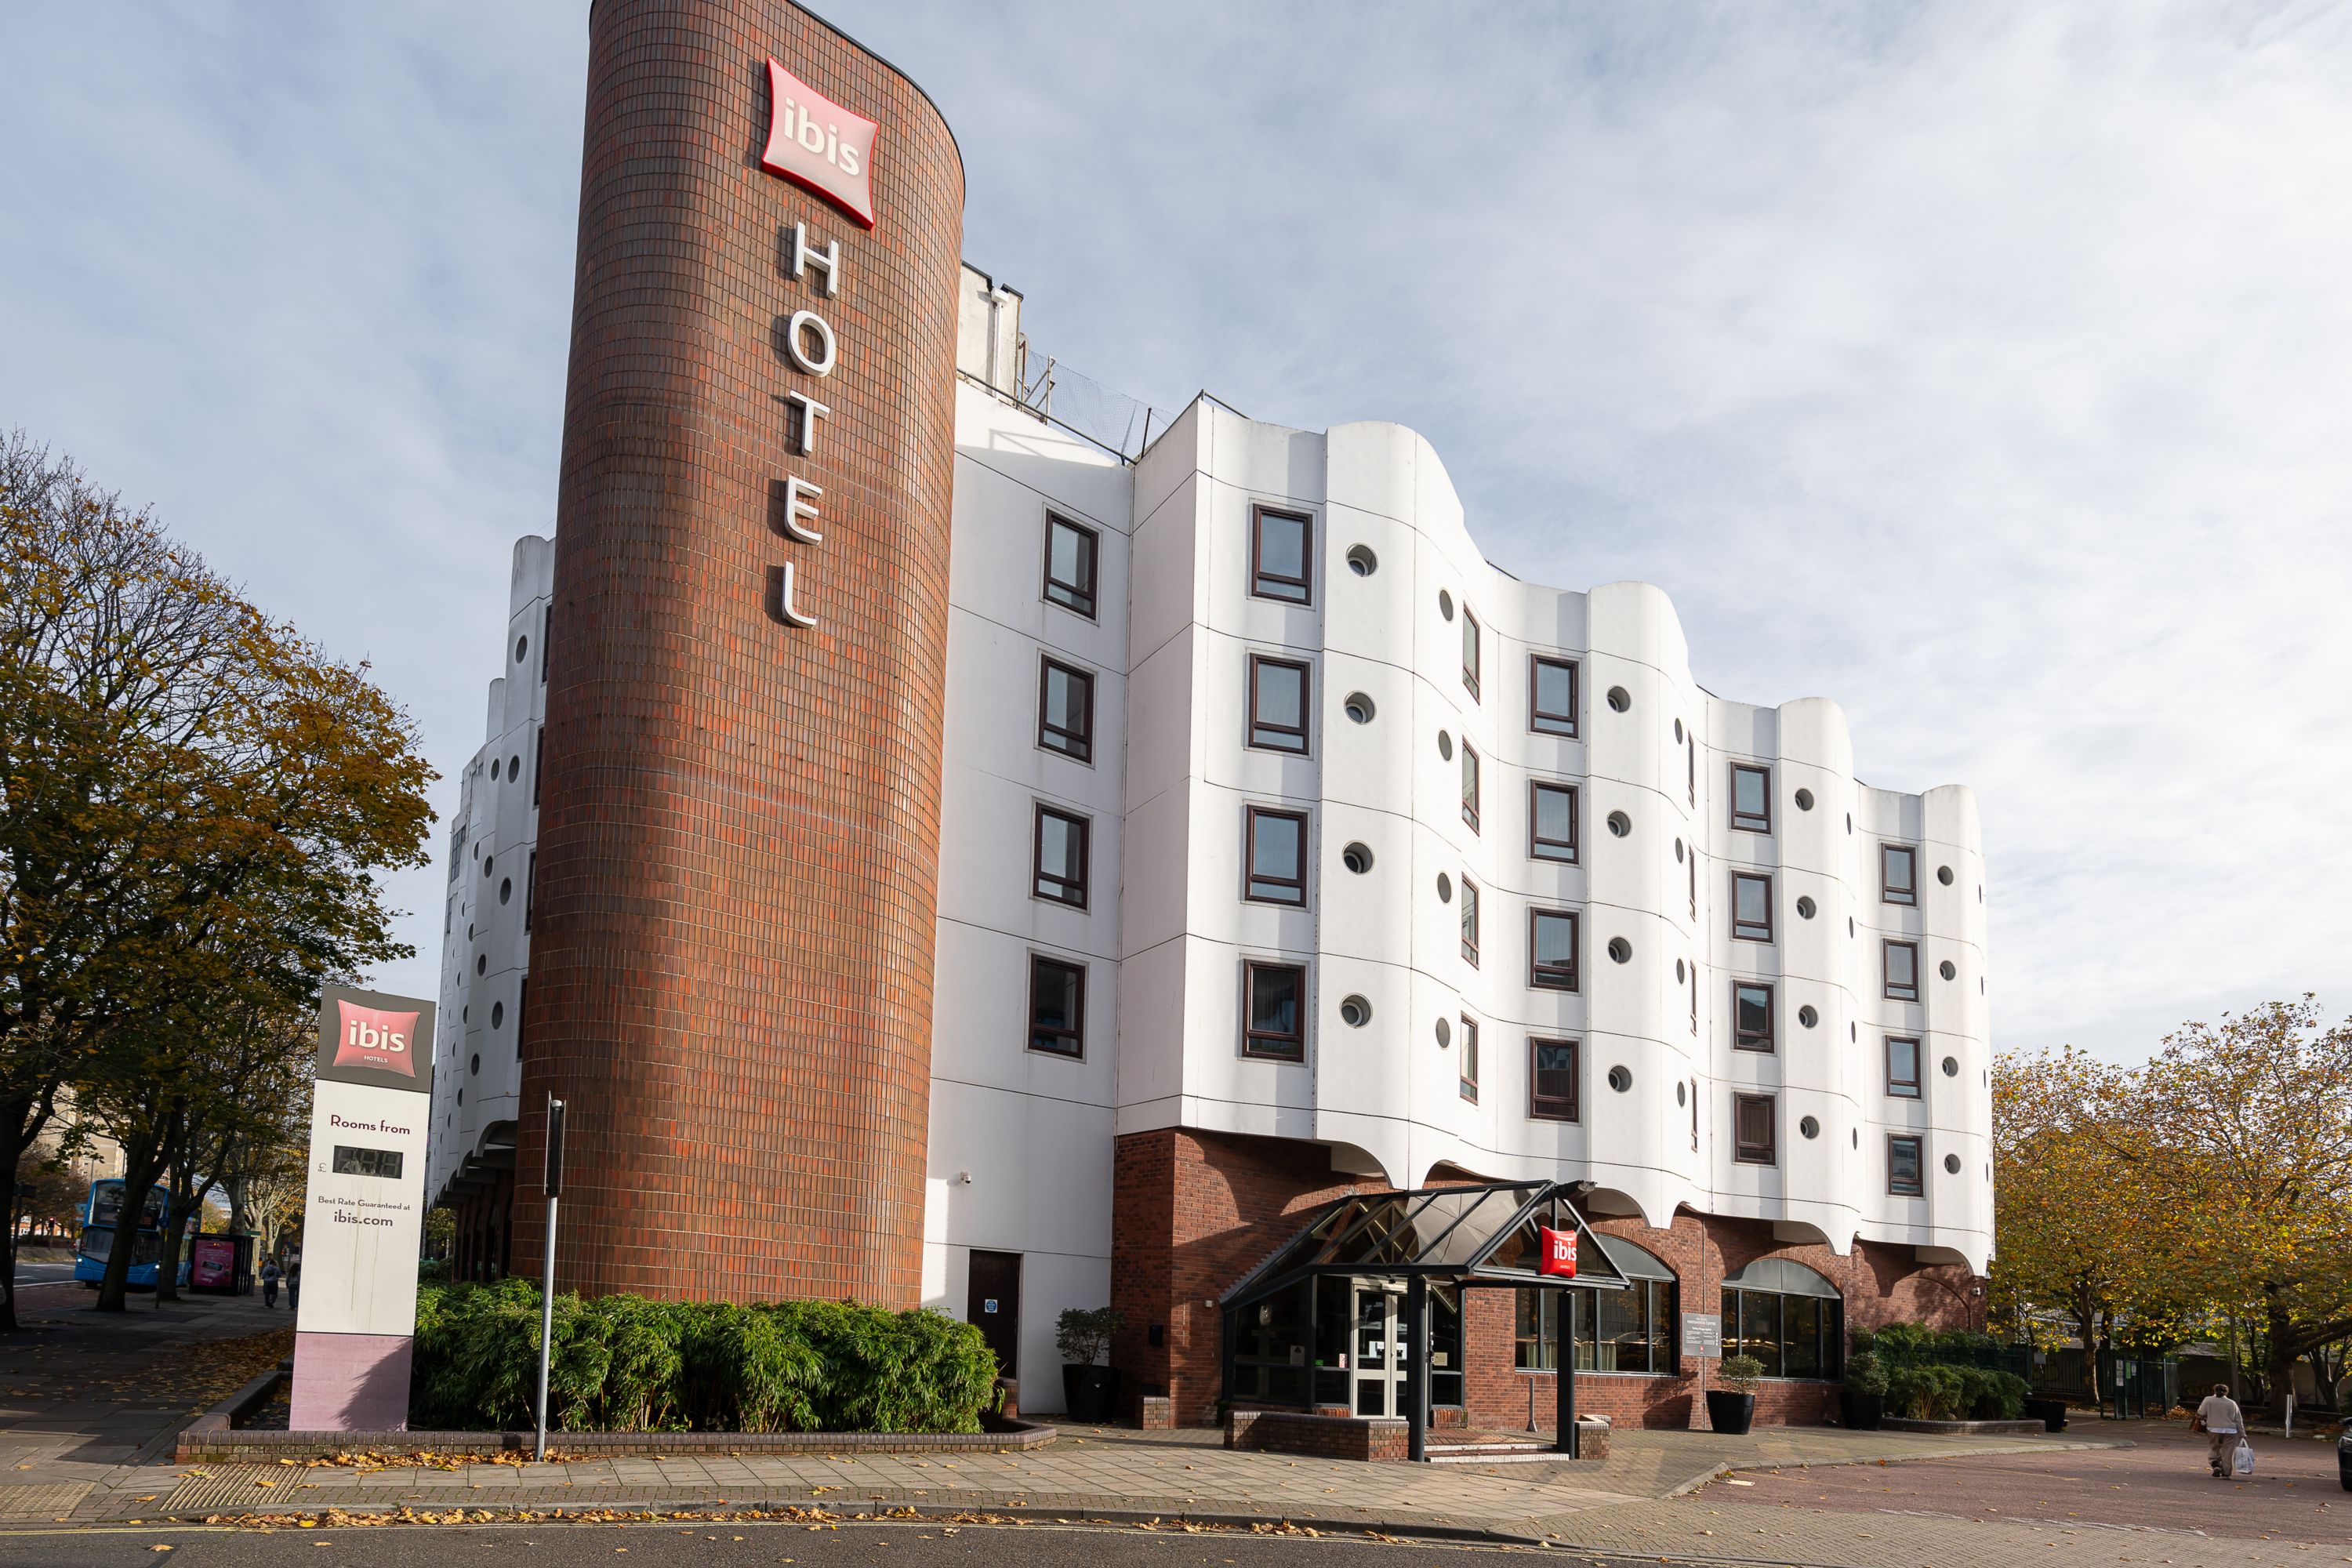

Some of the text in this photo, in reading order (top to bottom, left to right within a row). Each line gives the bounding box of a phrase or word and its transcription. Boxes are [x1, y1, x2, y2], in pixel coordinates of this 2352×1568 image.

[784, 97, 860, 176] ibis
[782, 221, 839, 630] HOTEL
[349, 1020, 405, 1052] ibis
[330, 1114, 410, 1134] Rooms from
[318, 1196, 336, 1205] Best
[358, 1200, 402, 1210] Guaranteed
[334, 1209, 393, 1226] ibis.com
[1553, 1240, 1577, 1261] ibis
